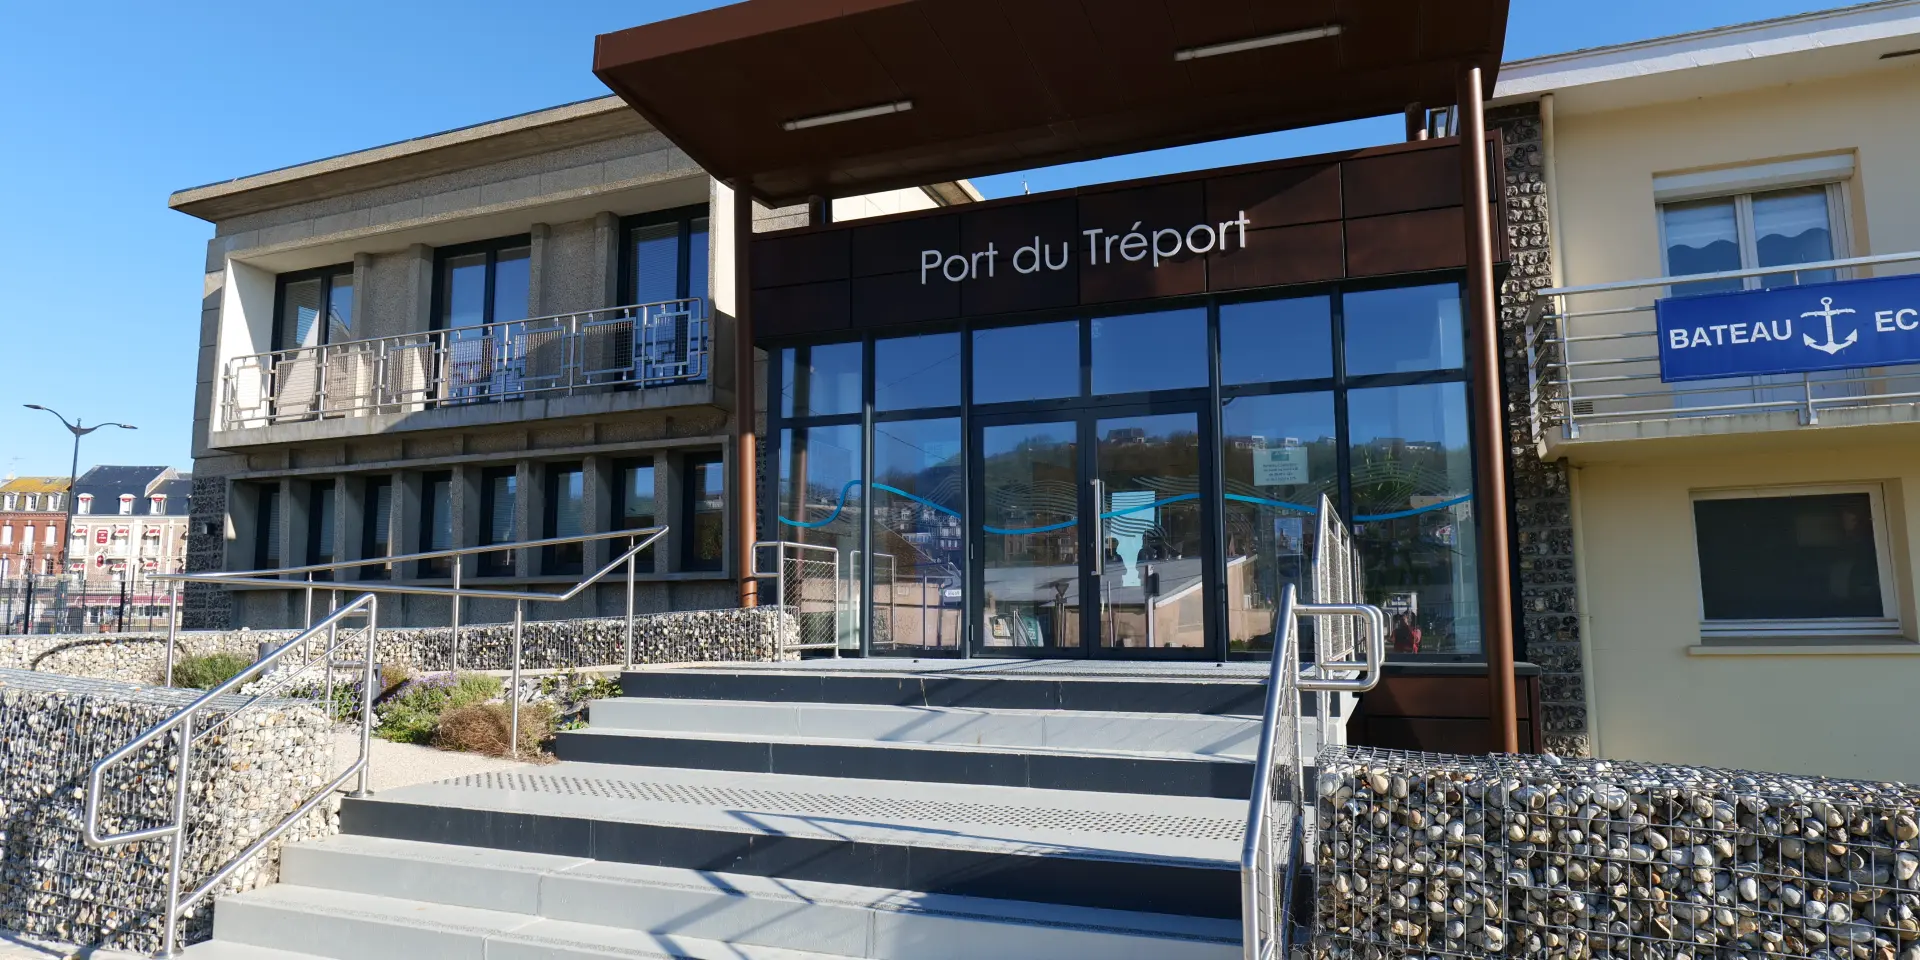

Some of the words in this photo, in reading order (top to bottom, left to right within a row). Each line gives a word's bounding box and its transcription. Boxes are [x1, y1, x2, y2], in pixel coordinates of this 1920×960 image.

[921, 241, 999, 285] Port
[1012, 235, 1069, 275] du
[1082, 210, 1251, 268] Tréport
[1669, 319, 1792, 350] BATEAU
